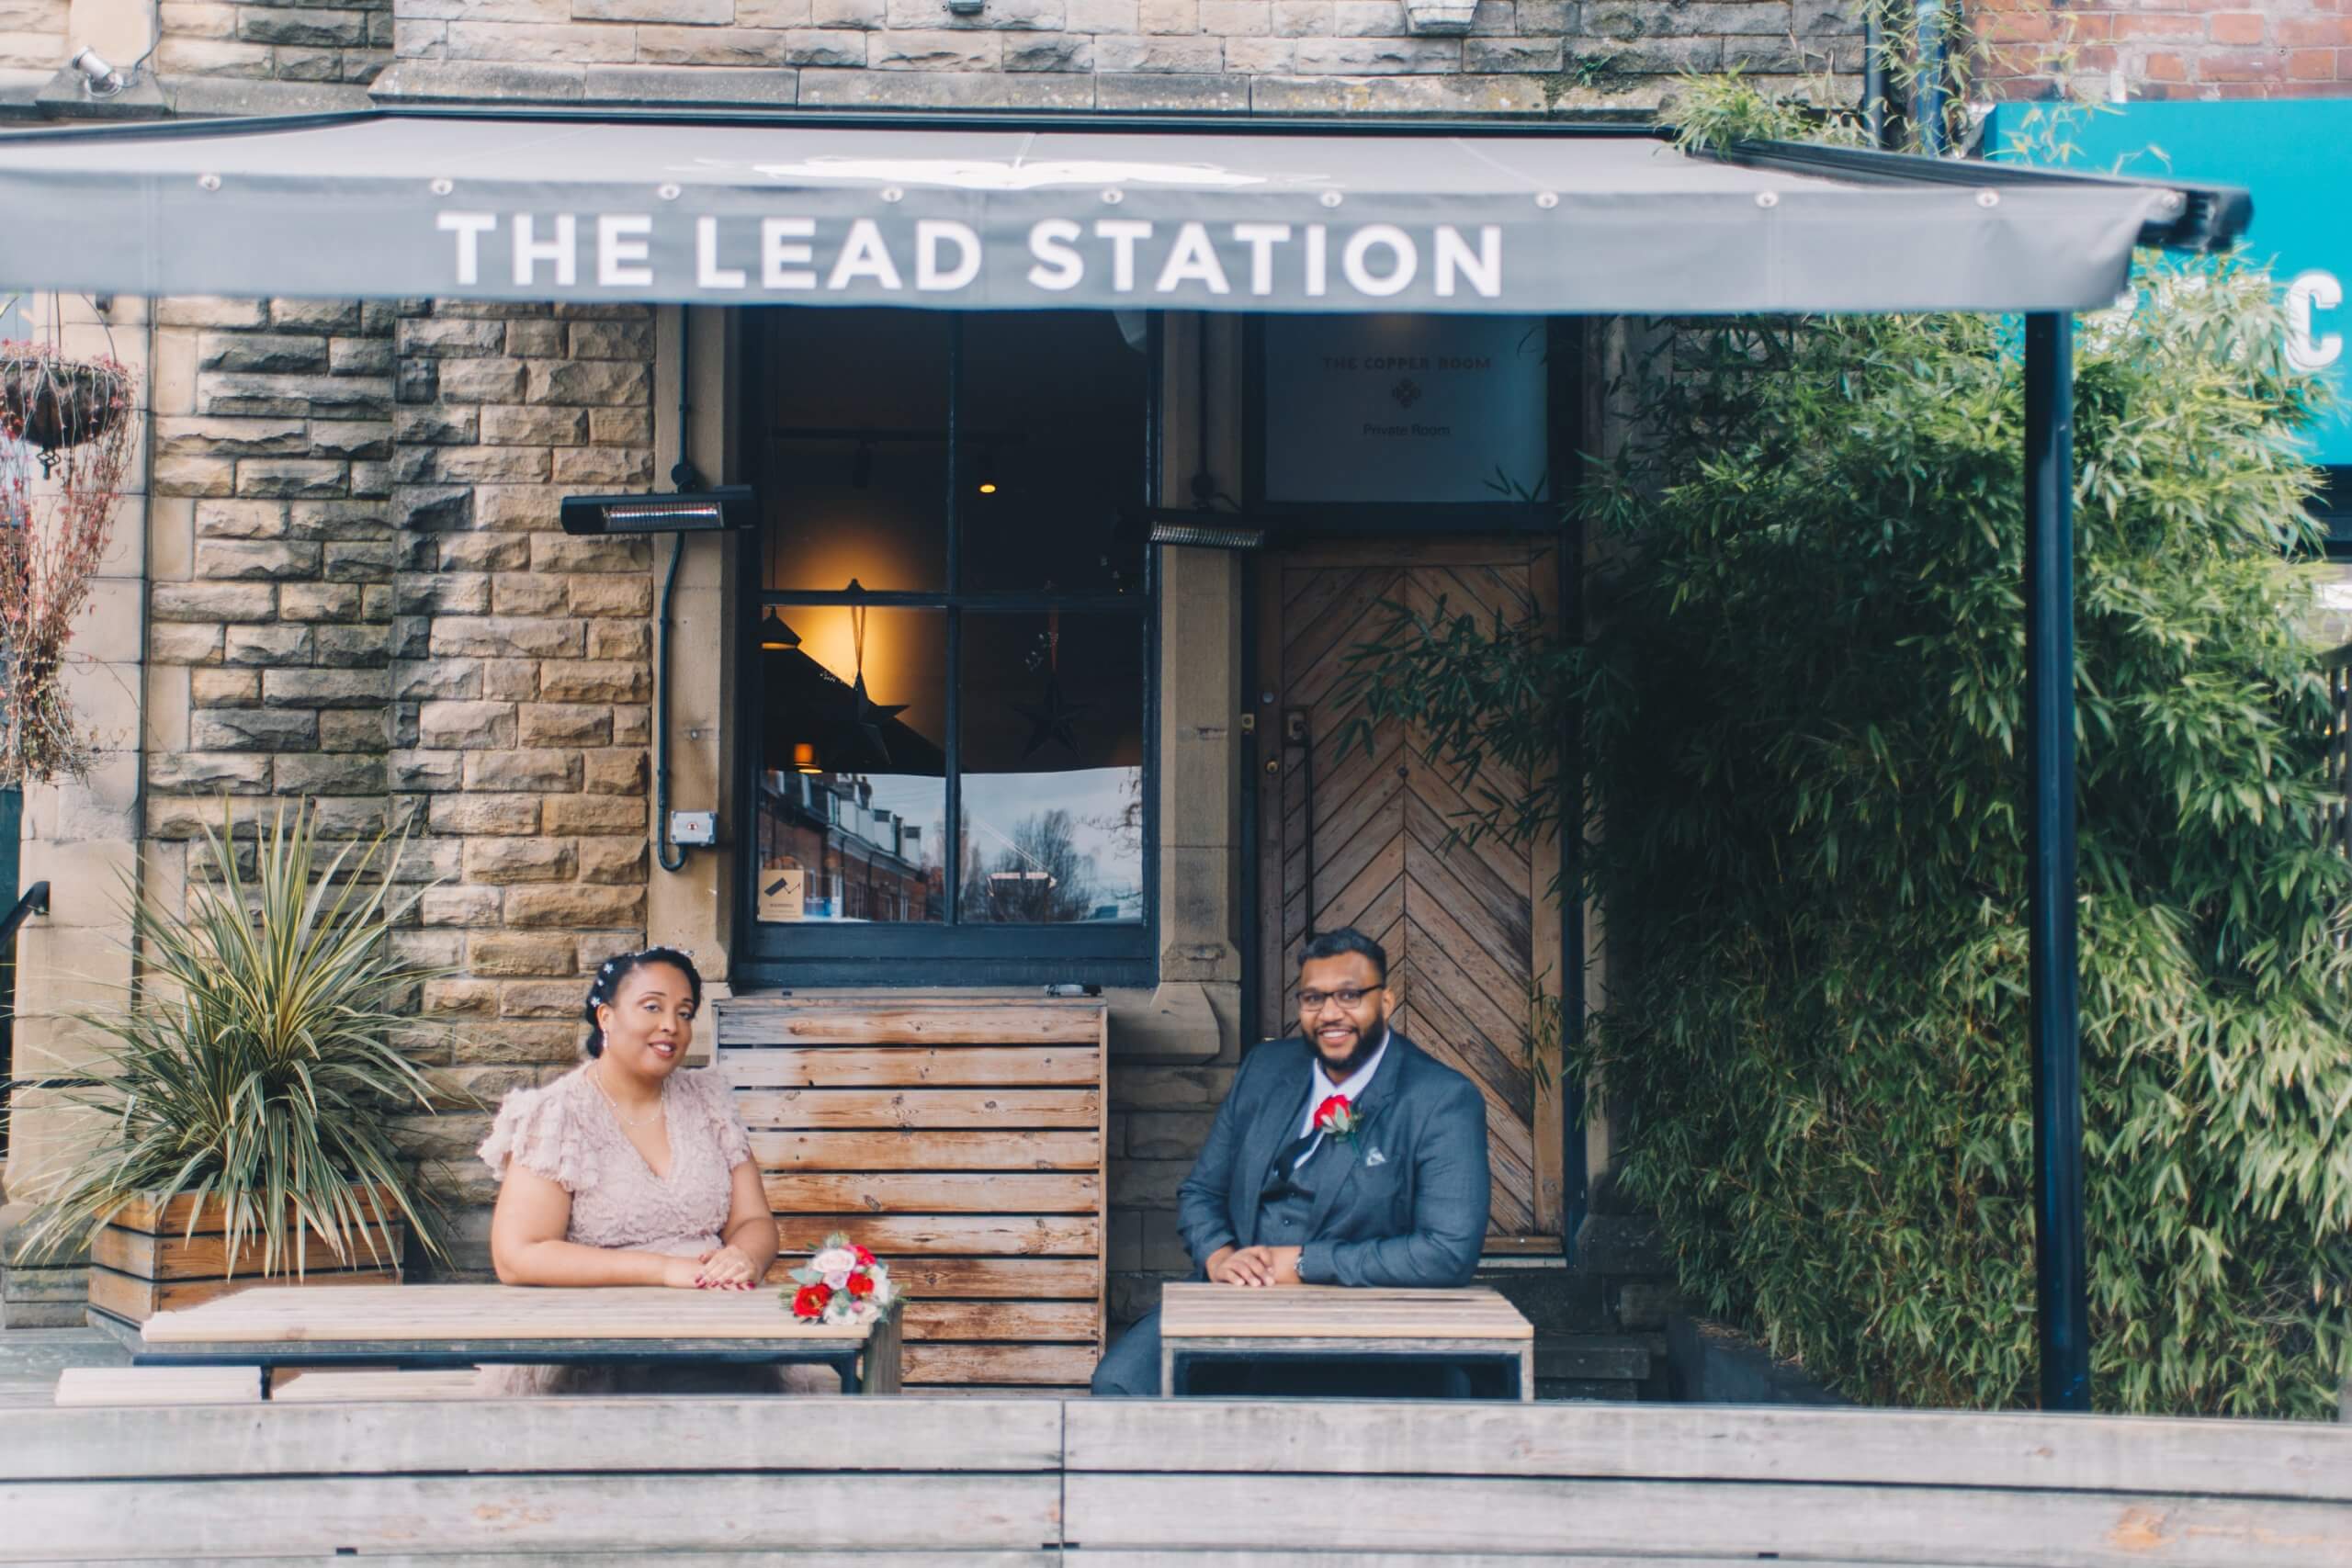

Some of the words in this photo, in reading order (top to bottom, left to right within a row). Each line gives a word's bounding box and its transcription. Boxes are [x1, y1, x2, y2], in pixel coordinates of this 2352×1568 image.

[435, 211, 654, 287] THE
[696, 215, 983, 291] LEAD
[1026, 218, 1502, 299] STATION
[1322, 356, 1357, 369] THE
[1364, 356, 1429, 369] COPPER
[1438, 356, 1492, 369] ROOM
[1363, 423, 1408, 436] Private
[1411, 423, 1451, 436] Room
